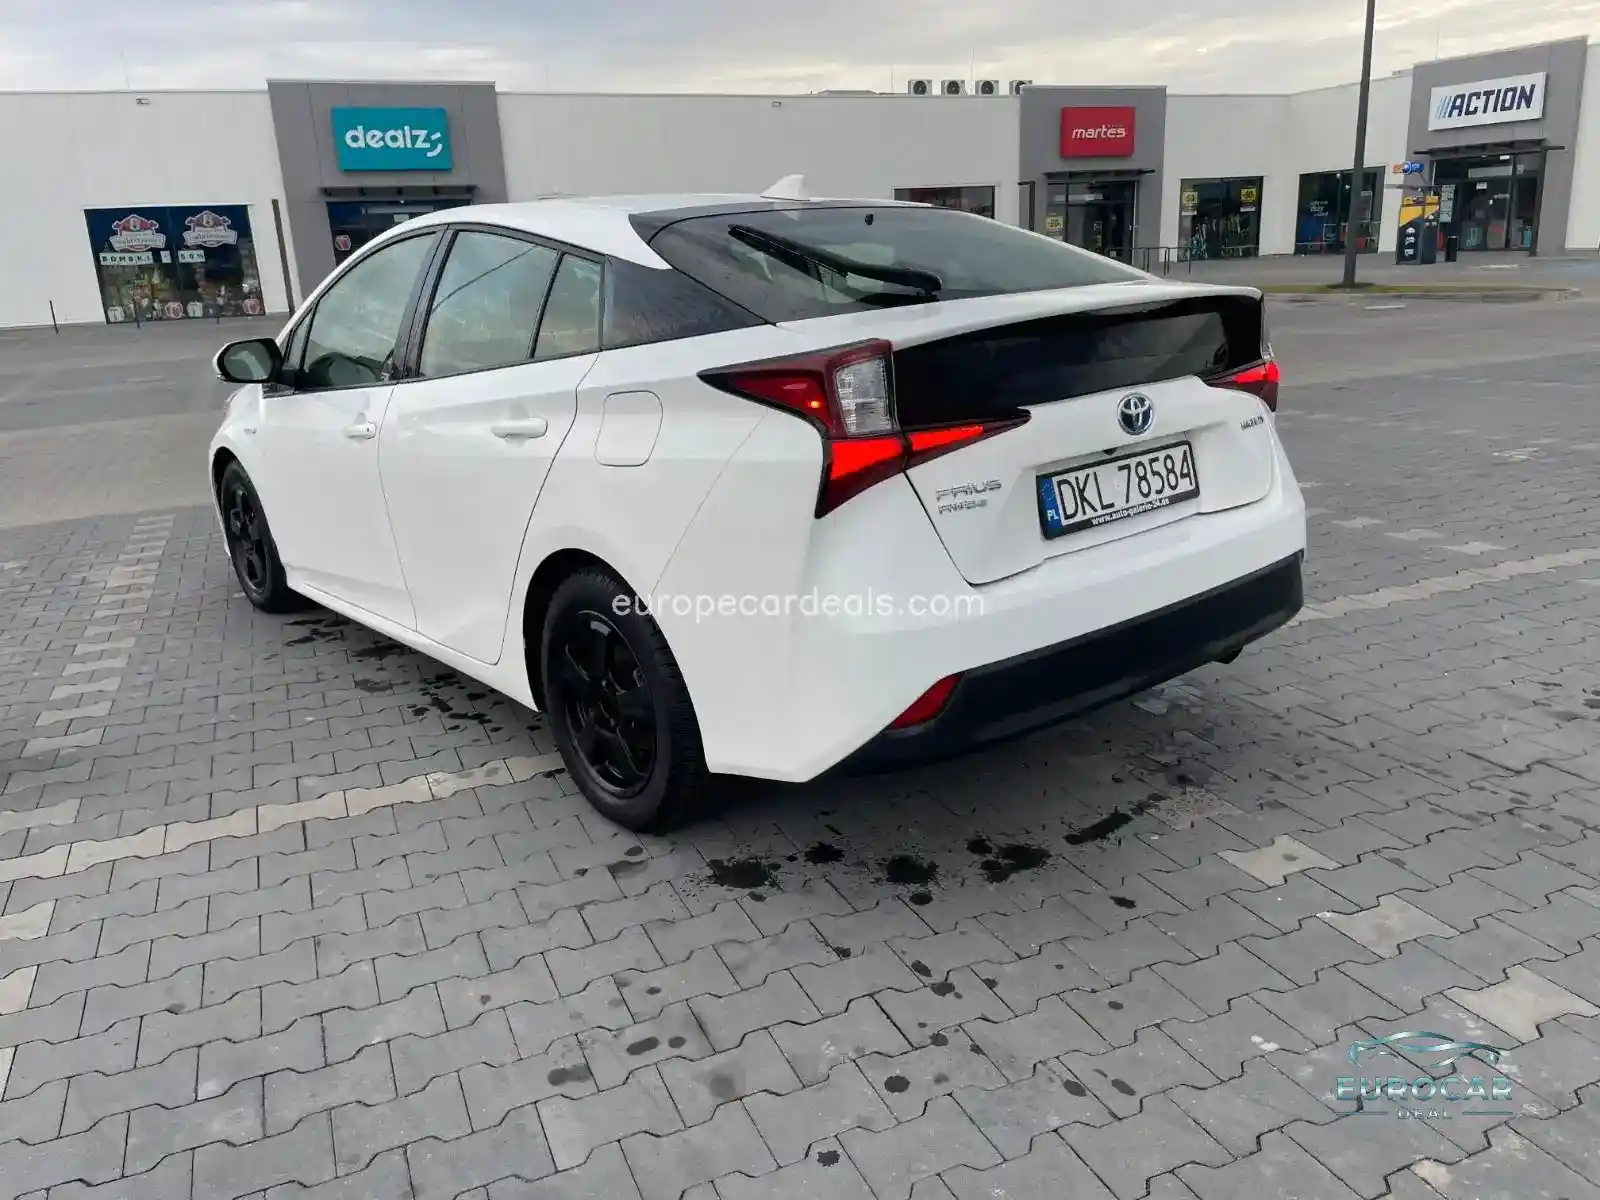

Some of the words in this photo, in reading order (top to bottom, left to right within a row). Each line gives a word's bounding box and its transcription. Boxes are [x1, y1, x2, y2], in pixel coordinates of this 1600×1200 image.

[1447, 83, 1536, 118] ACTION
[344, 125, 432, 149] dealz
[935, 478, 1003, 502] PRIUS
[1056, 471, 1115, 521] DKL
[1117, 449, 1194, 505] 78584
[1047, 510, 1060, 521] PL
